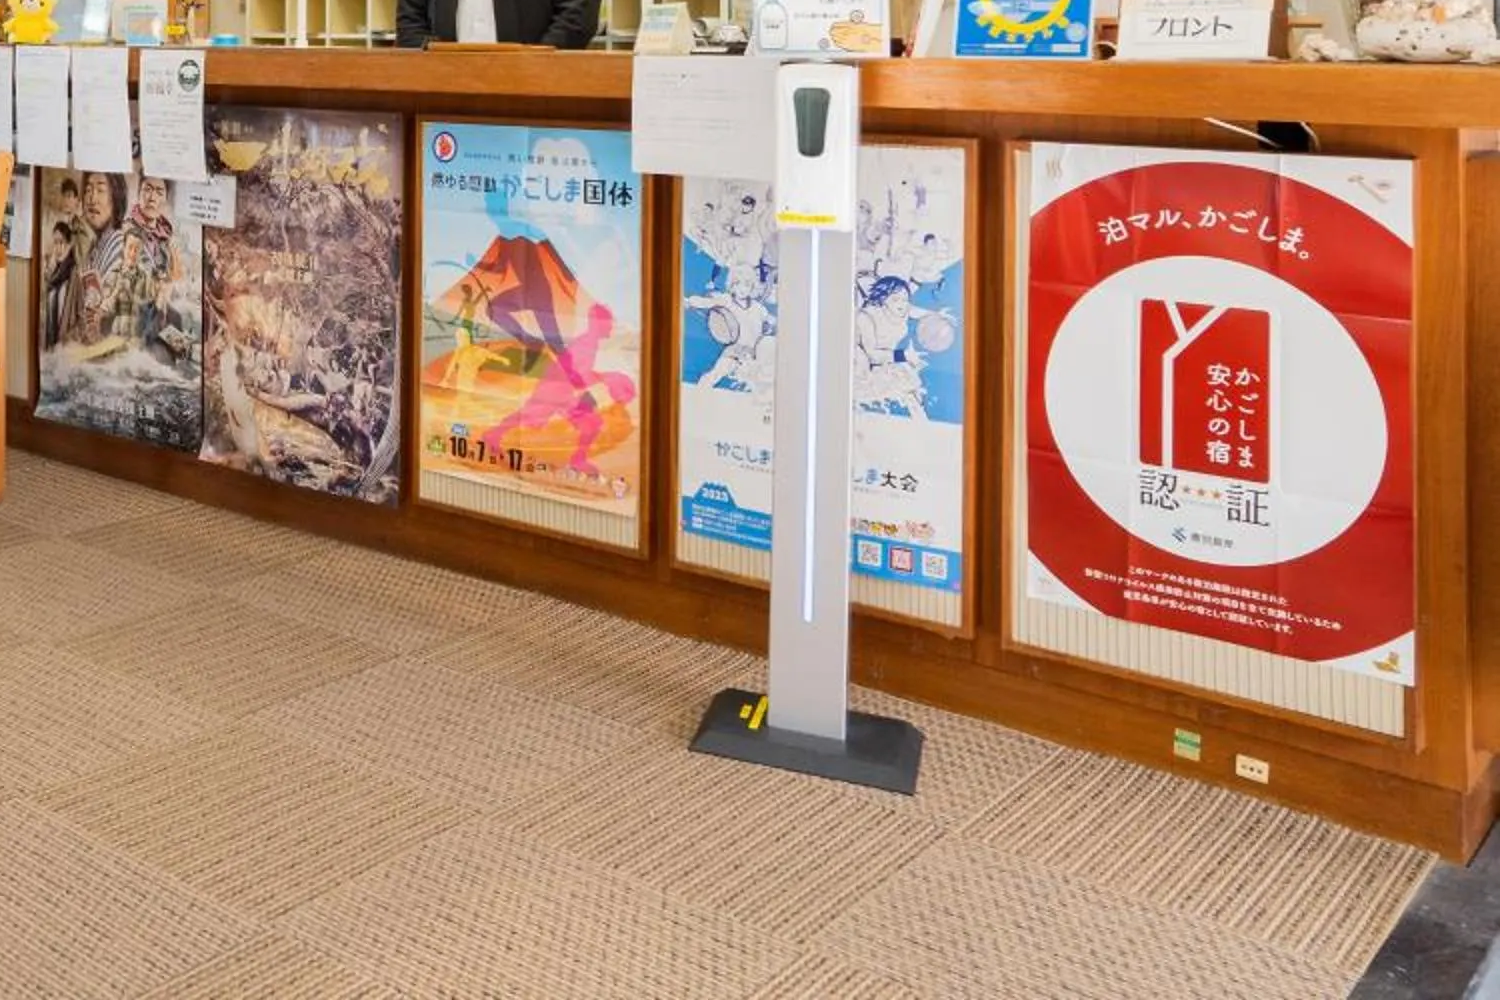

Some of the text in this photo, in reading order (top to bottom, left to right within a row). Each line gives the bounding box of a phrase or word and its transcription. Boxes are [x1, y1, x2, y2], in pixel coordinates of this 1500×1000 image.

[1147, 15, 1234, 37] フロント
[1097, 205, 1309, 260] 泊マル、かごしま。
[1205, 362, 1232, 465] 安心の宿
[1234, 367, 1261, 469] かごしま
[1138, 470, 1271, 527] 認 証
